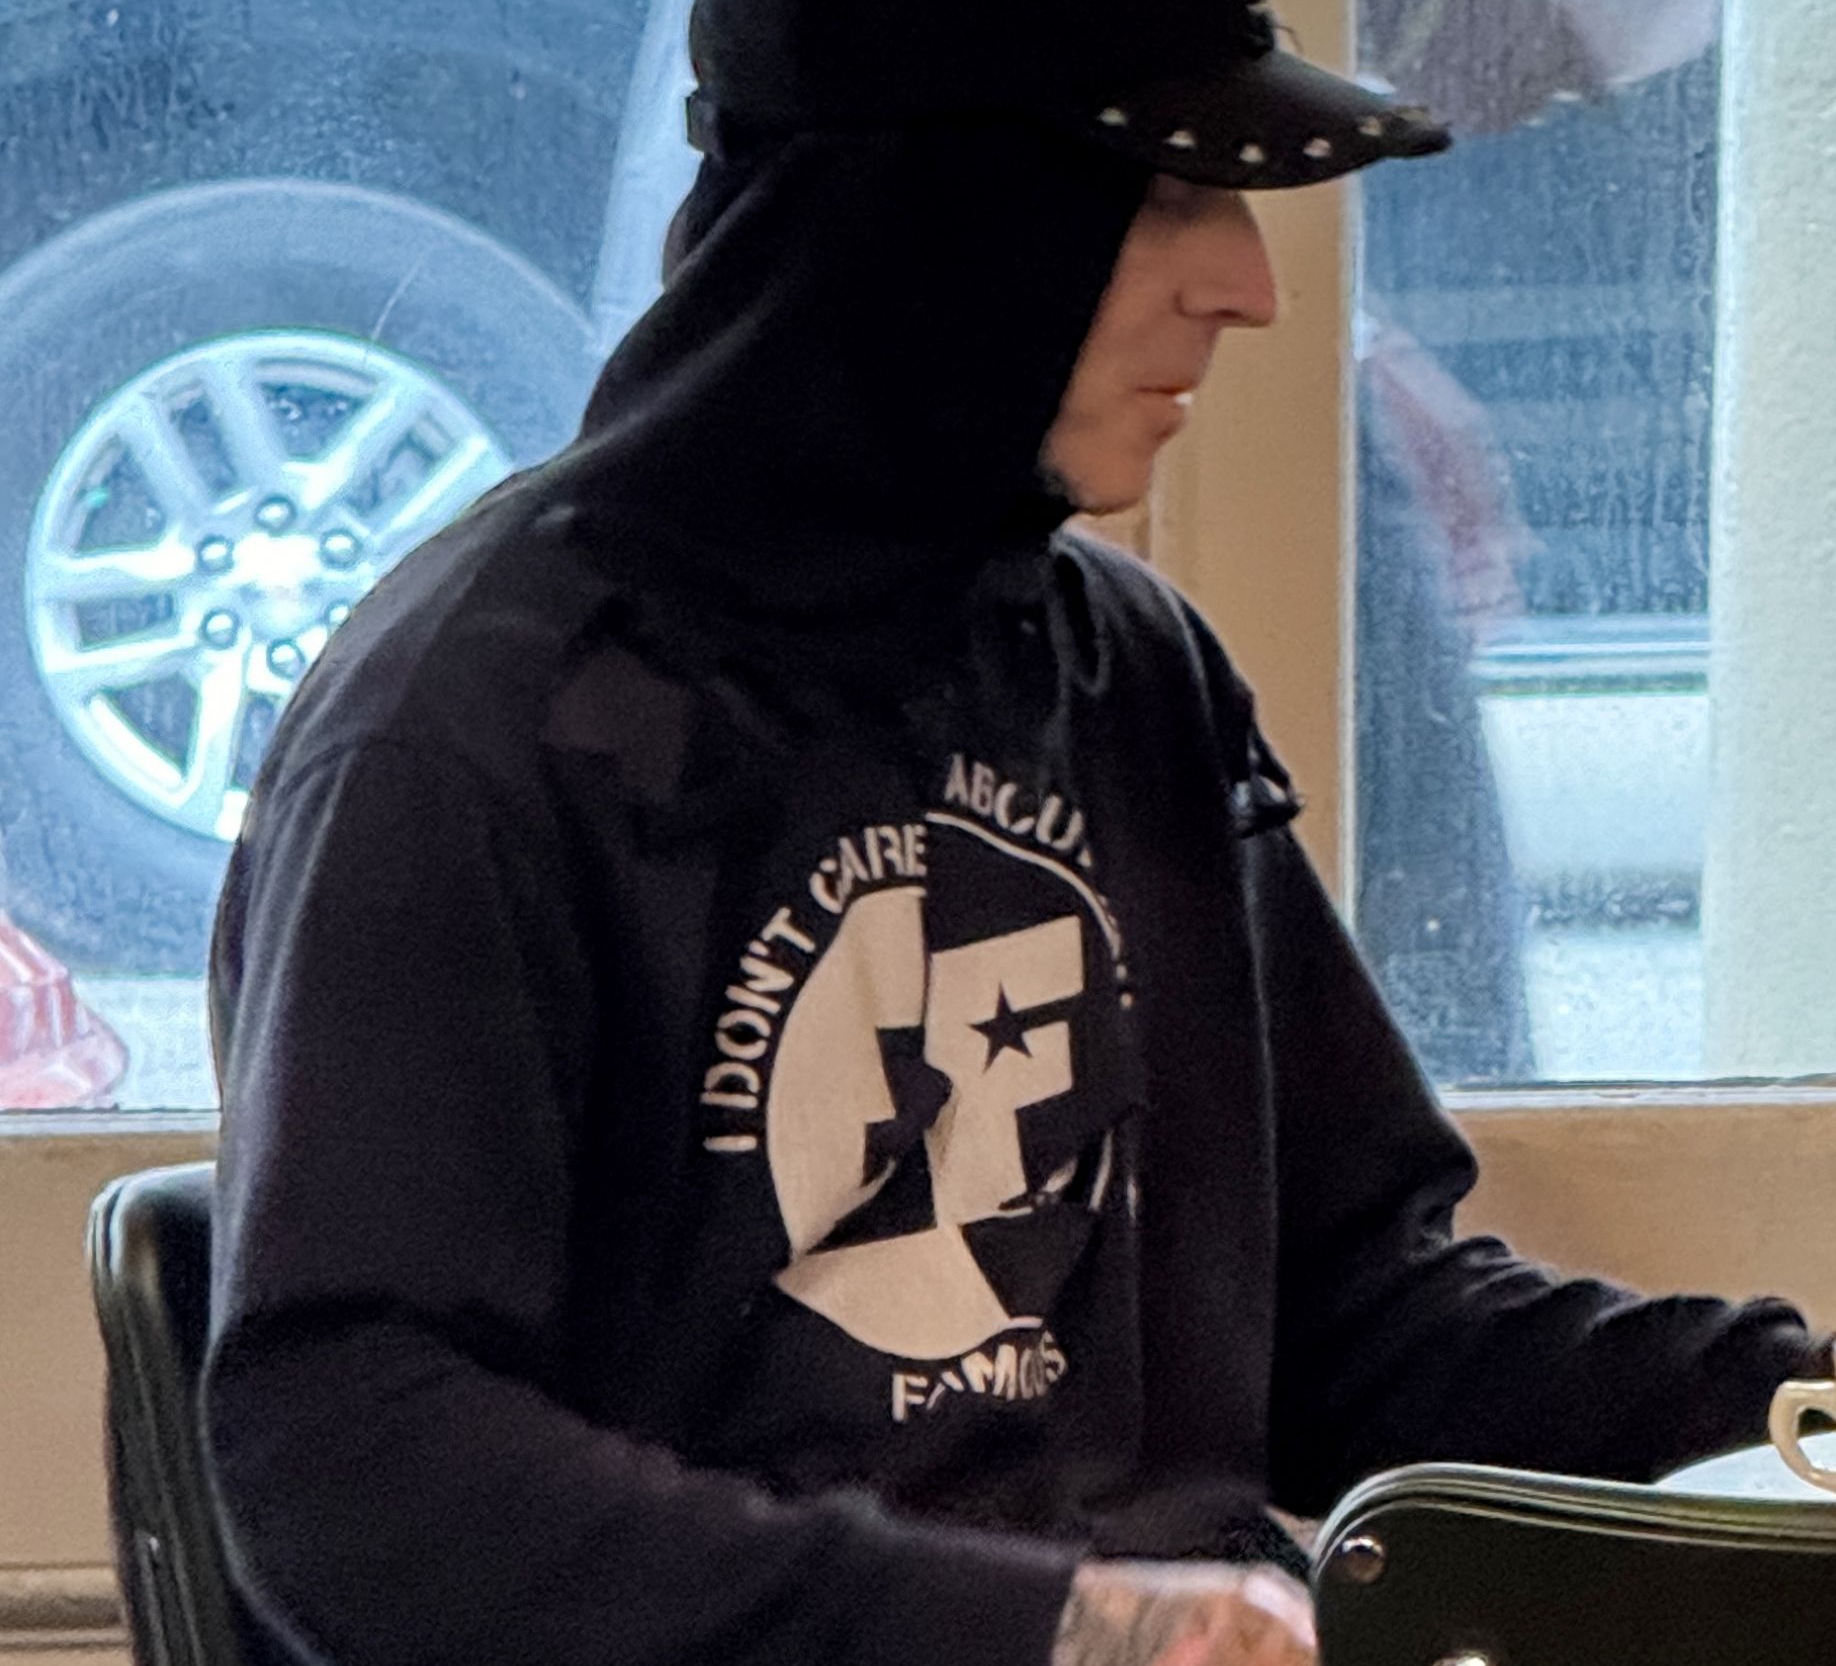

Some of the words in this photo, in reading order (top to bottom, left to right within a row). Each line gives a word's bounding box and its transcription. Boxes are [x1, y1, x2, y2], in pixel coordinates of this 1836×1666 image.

[700, 906, 816, 1110] DON'T
[808, 823, 928, 915] CARE
[943, 753, 1093, 869] ABOU
